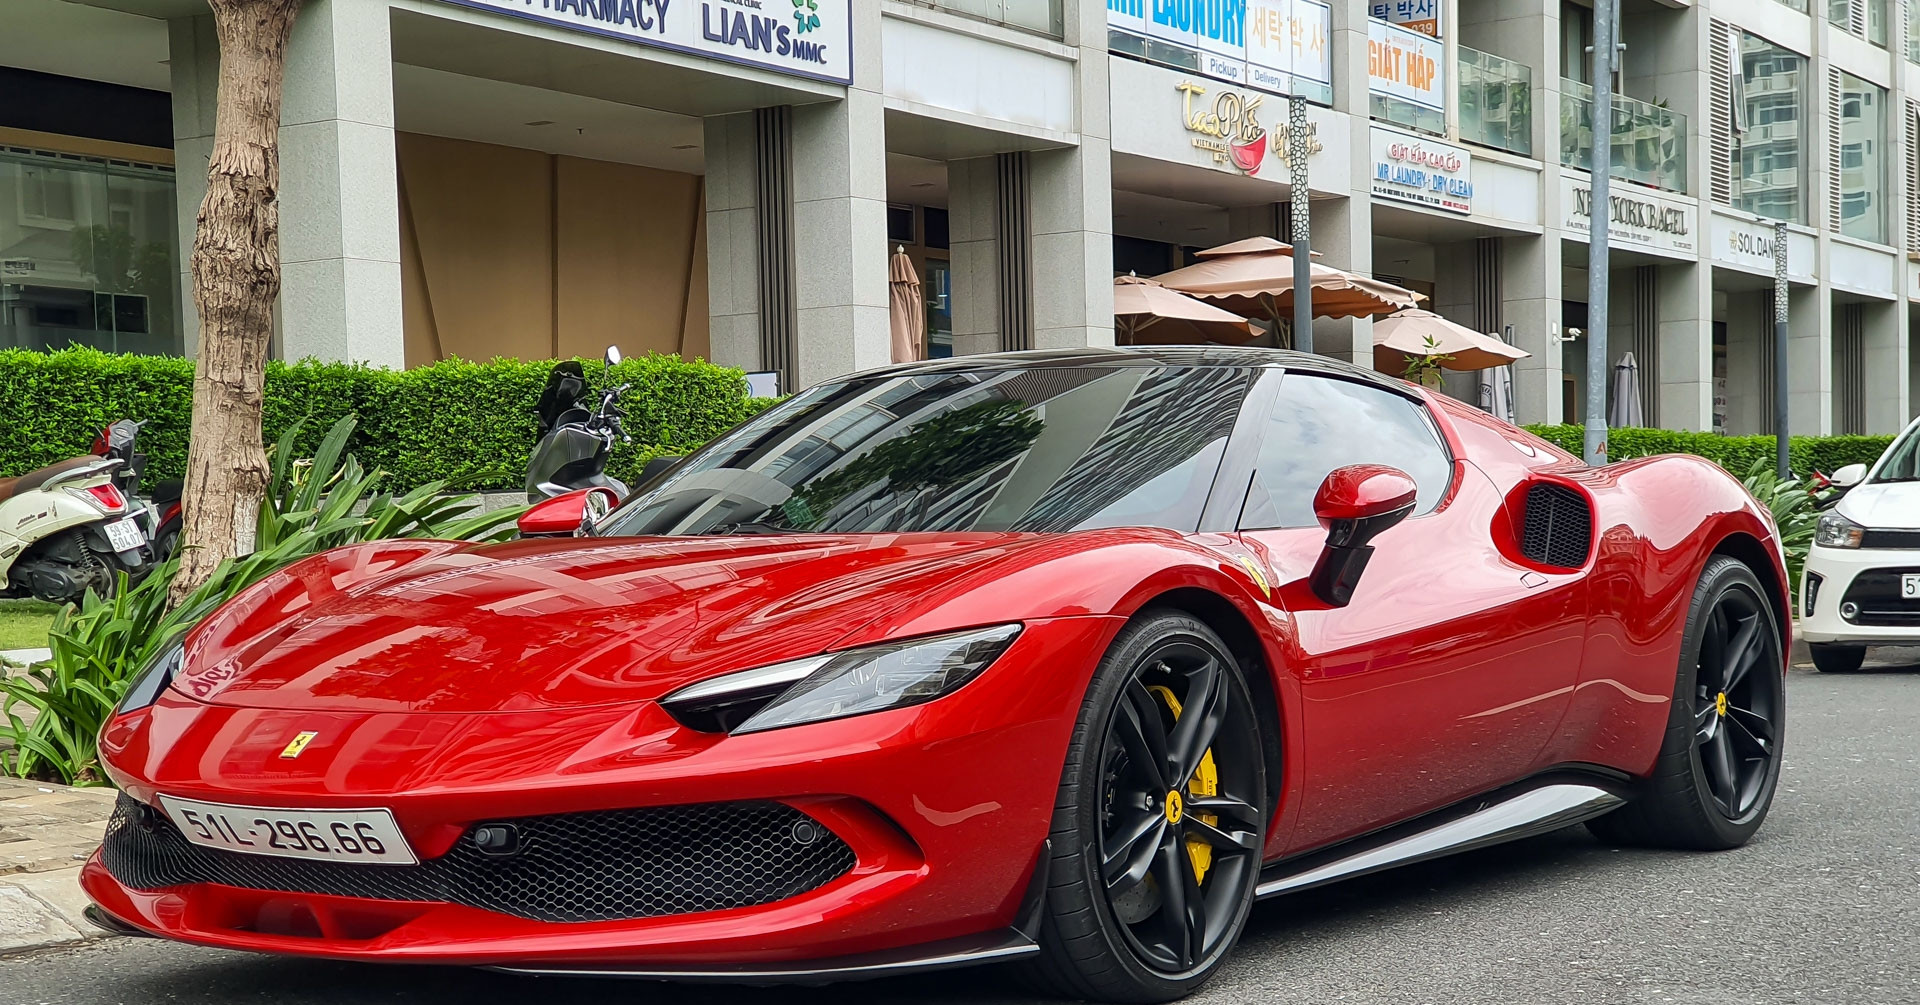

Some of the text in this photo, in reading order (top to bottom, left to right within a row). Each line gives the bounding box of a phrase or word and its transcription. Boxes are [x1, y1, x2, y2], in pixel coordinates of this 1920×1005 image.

[792, 39, 828, 65] MMC
[1406, 43, 1435, 92] HẤP
[1210, 58, 1281, 89] Pickup Delivery
[1429, 152, 1444, 169] CAO
[1377, 162, 1389, 180] MR
[1391, 165, 1427, 188] LAUNDRY
[1432, 174, 1448, 192] DRY
[1449, 178, 1473, 199] CLEAN
[1608, 194, 1647, 228] YORK
[1645, 203, 1688, 236] BAGEL
[1737, 232, 1777, 260] SOL DAN
[180, 808, 386, 855] 51L-296.66
